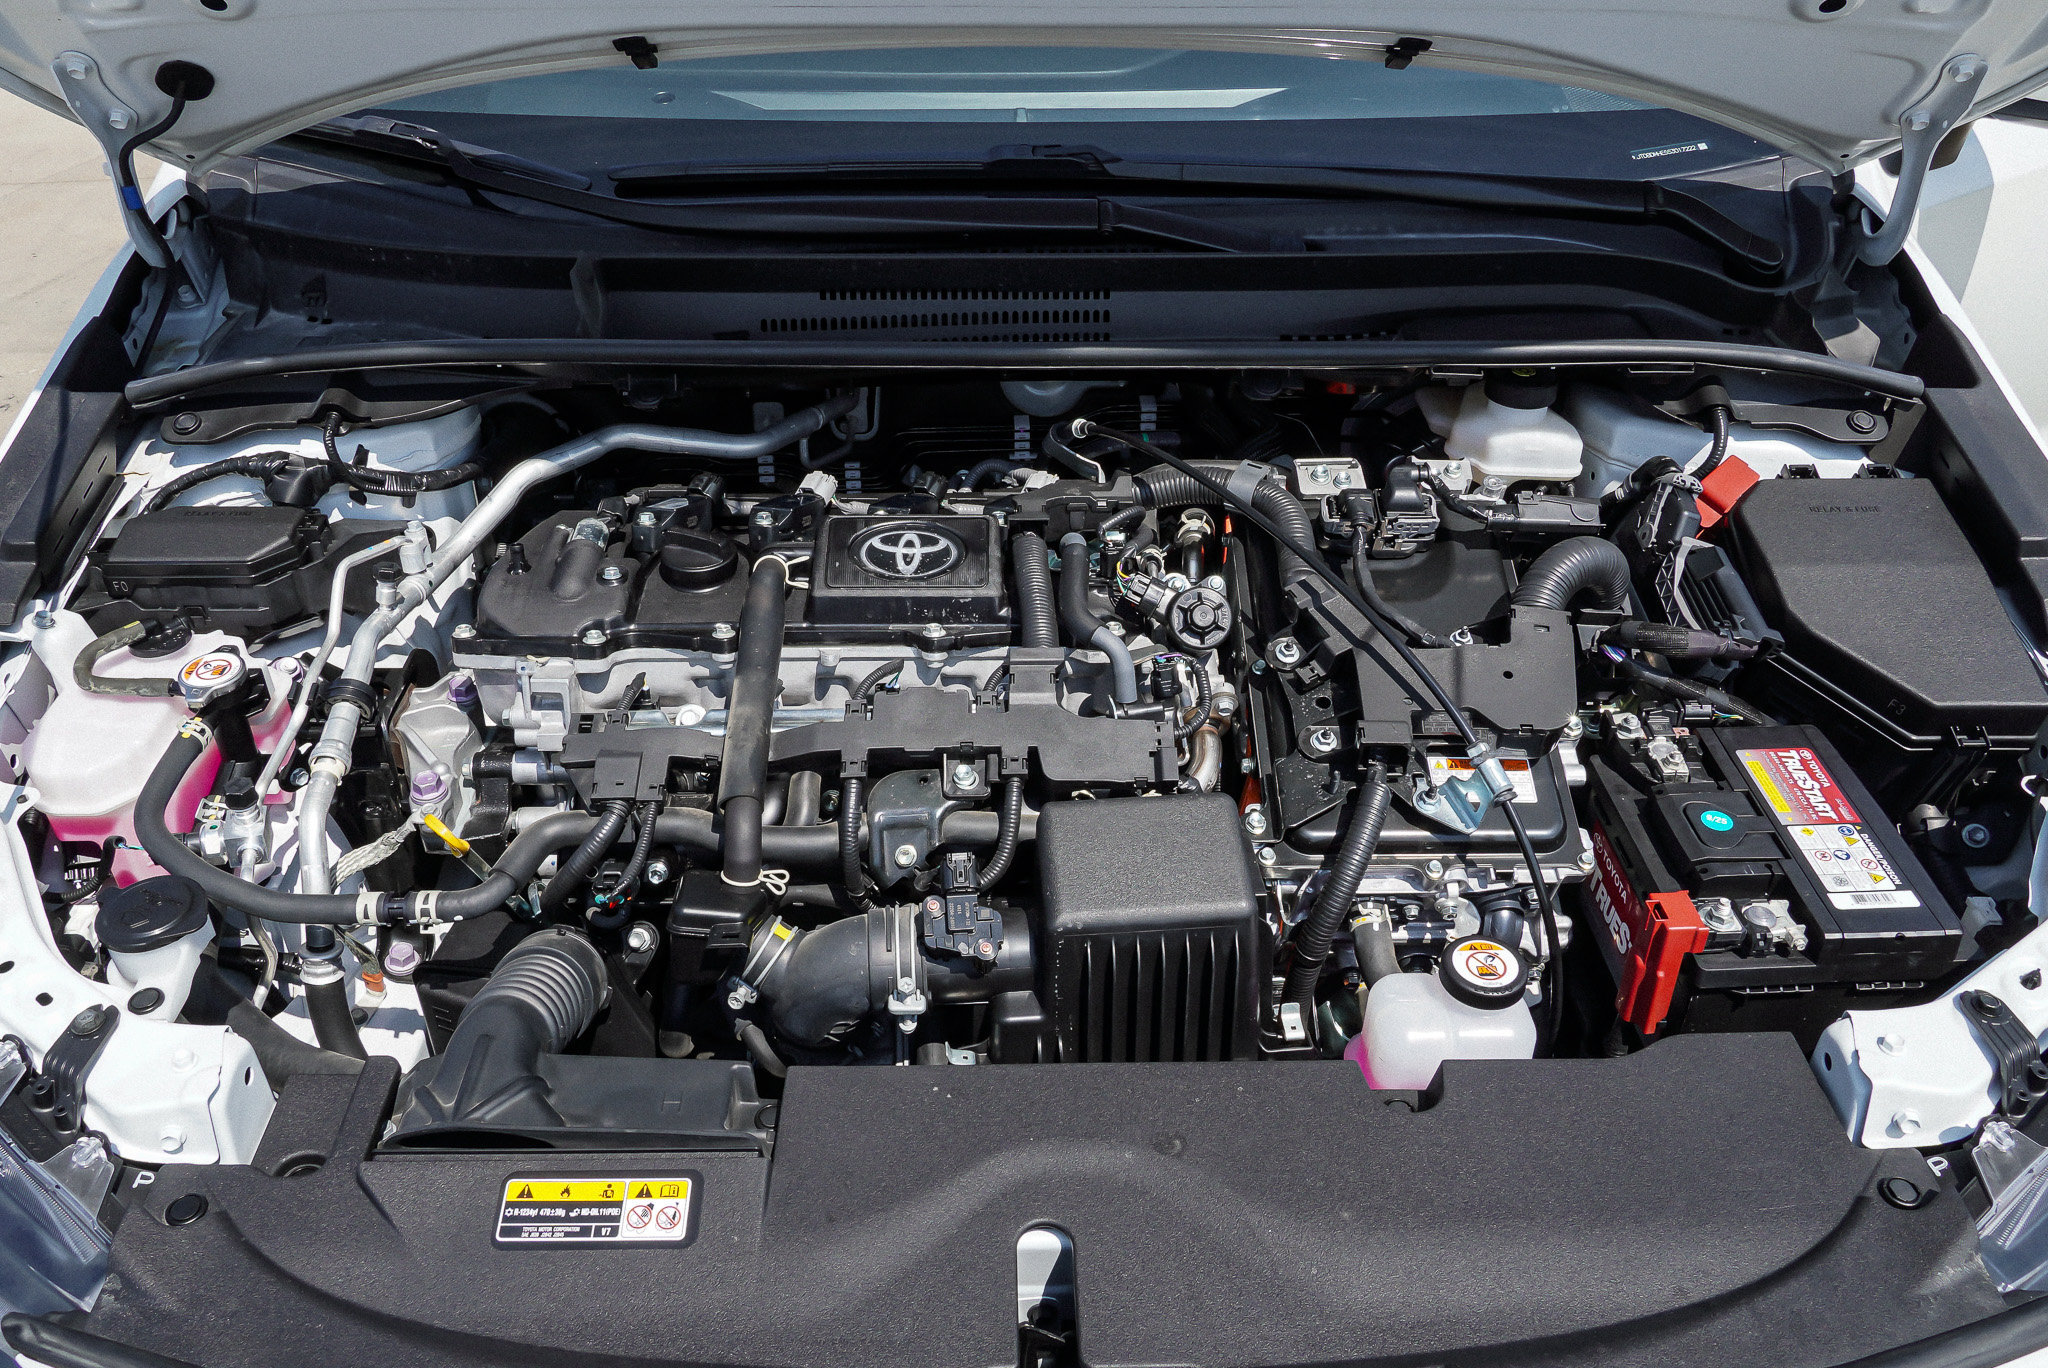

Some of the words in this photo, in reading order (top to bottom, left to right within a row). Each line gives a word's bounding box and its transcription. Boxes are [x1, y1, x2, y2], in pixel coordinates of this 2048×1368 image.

[1805, 760, 1831, 787] TOYOTA
[1603, 851, 1627, 904] TOYOTA
[1860, 833, 1903, 885] DANGER/POISON
[1590, 866, 1633, 955] TRUES
[132, 1171, 155, 1189] P
[1927, 1156, 1949, 1177] P
